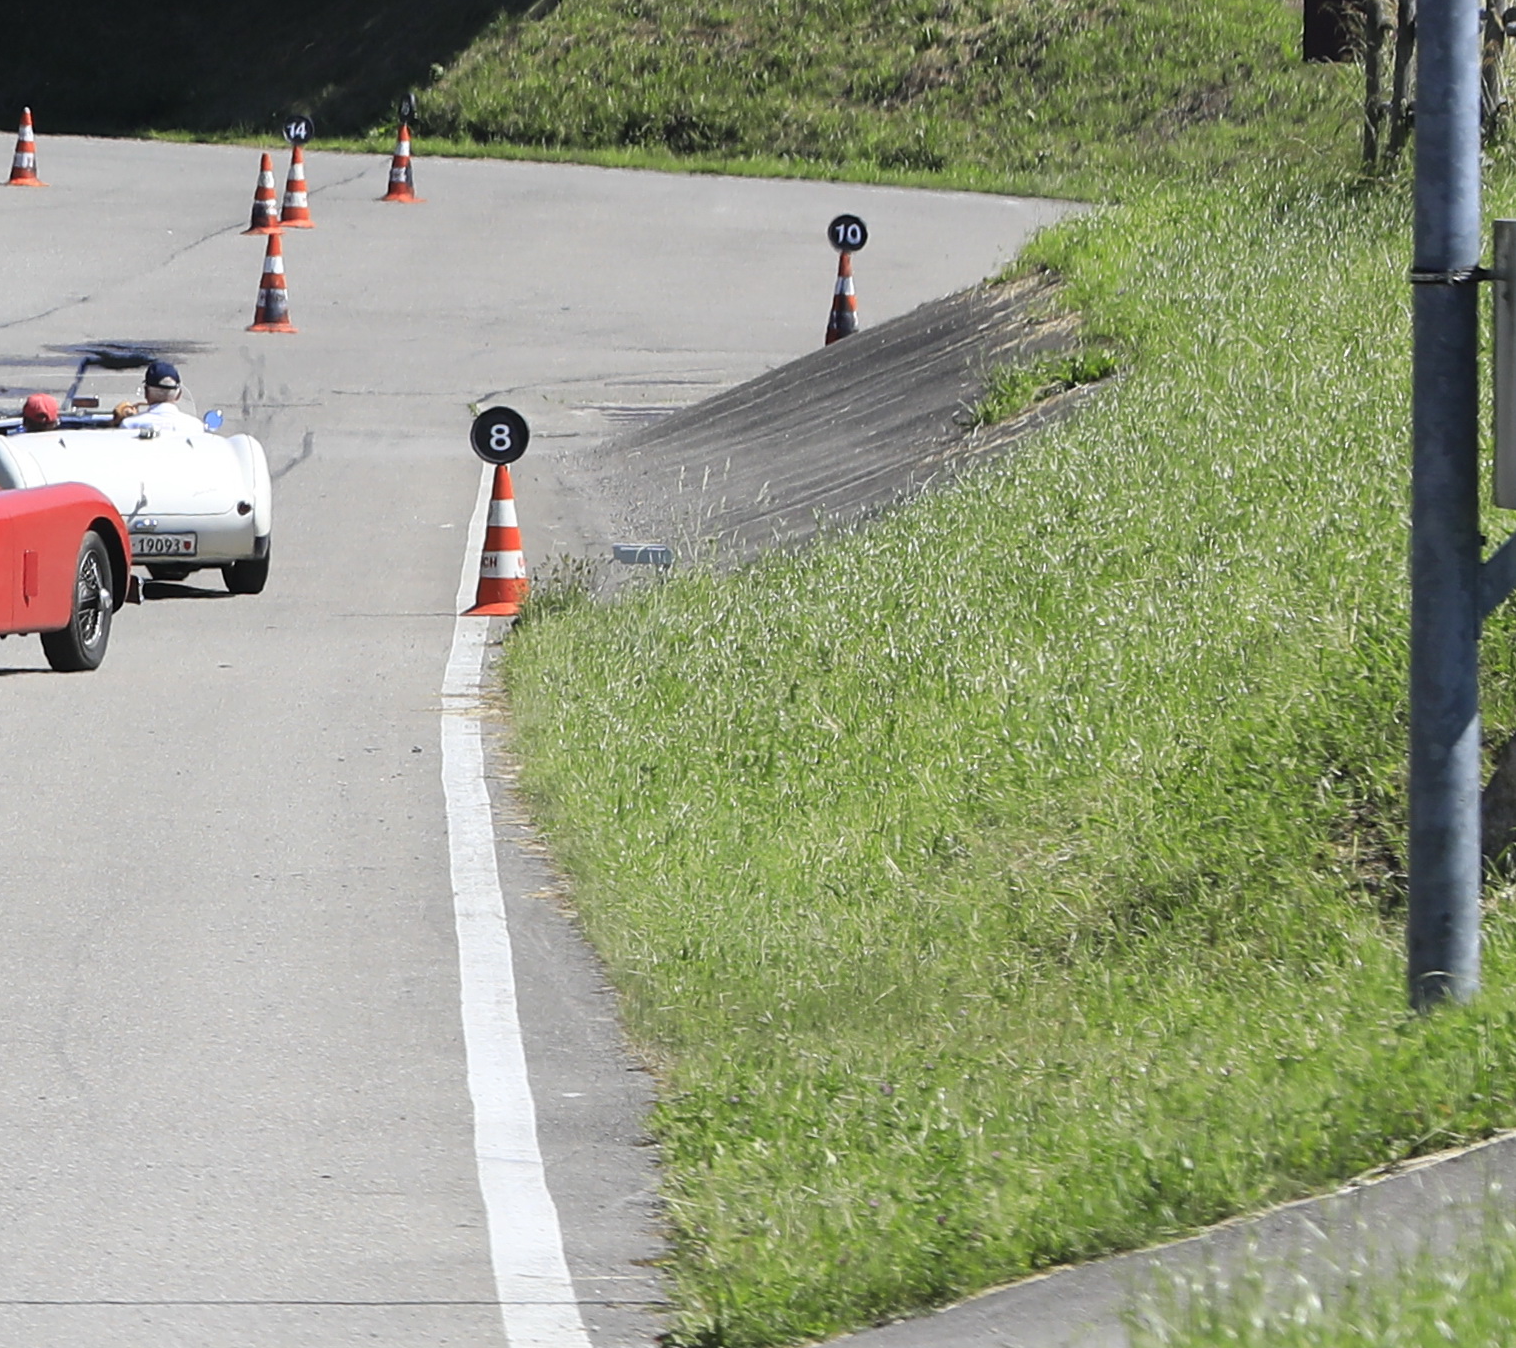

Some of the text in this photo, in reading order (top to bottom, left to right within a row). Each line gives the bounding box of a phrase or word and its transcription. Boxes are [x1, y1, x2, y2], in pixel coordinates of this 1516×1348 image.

[288, 121, 307, 139] 14
[835, 223, 862, 245] 10
[489, 423, 512, 452] 8
